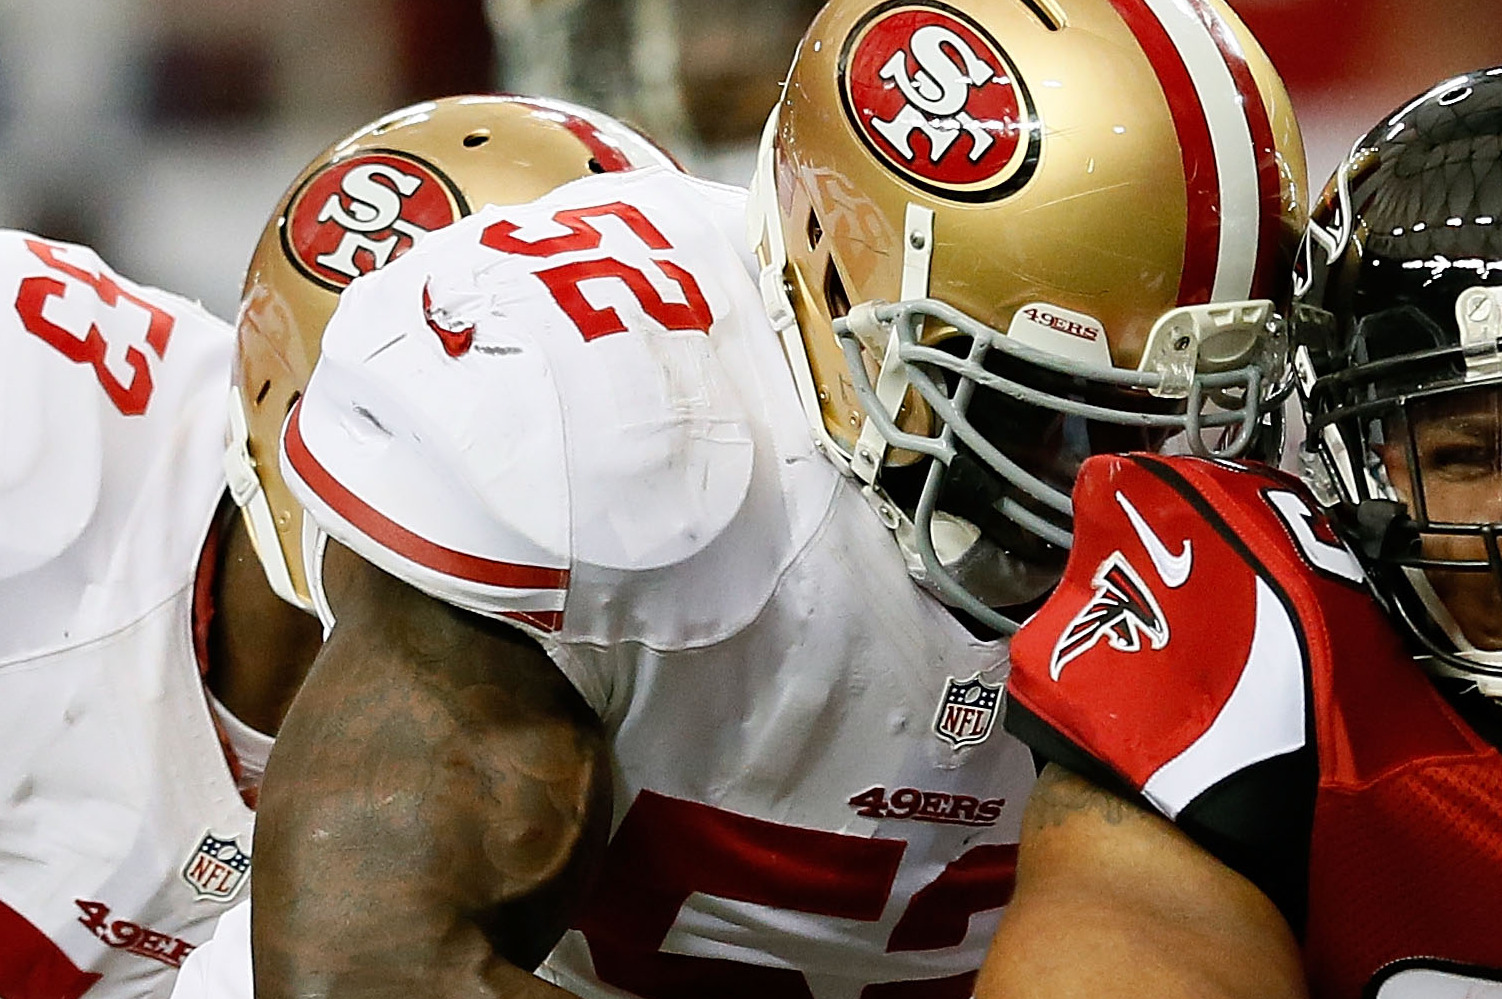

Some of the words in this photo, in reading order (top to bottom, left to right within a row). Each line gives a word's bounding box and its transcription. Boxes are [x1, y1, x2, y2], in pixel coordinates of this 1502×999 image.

[479, 200, 714, 342] 52
[1022, 308, 1100, 342] 49ERS
[942, 705, 985, 737] NFL
[848, 787, 1006, 826] 49ERS
[188, 854, 234, 893] NFL
